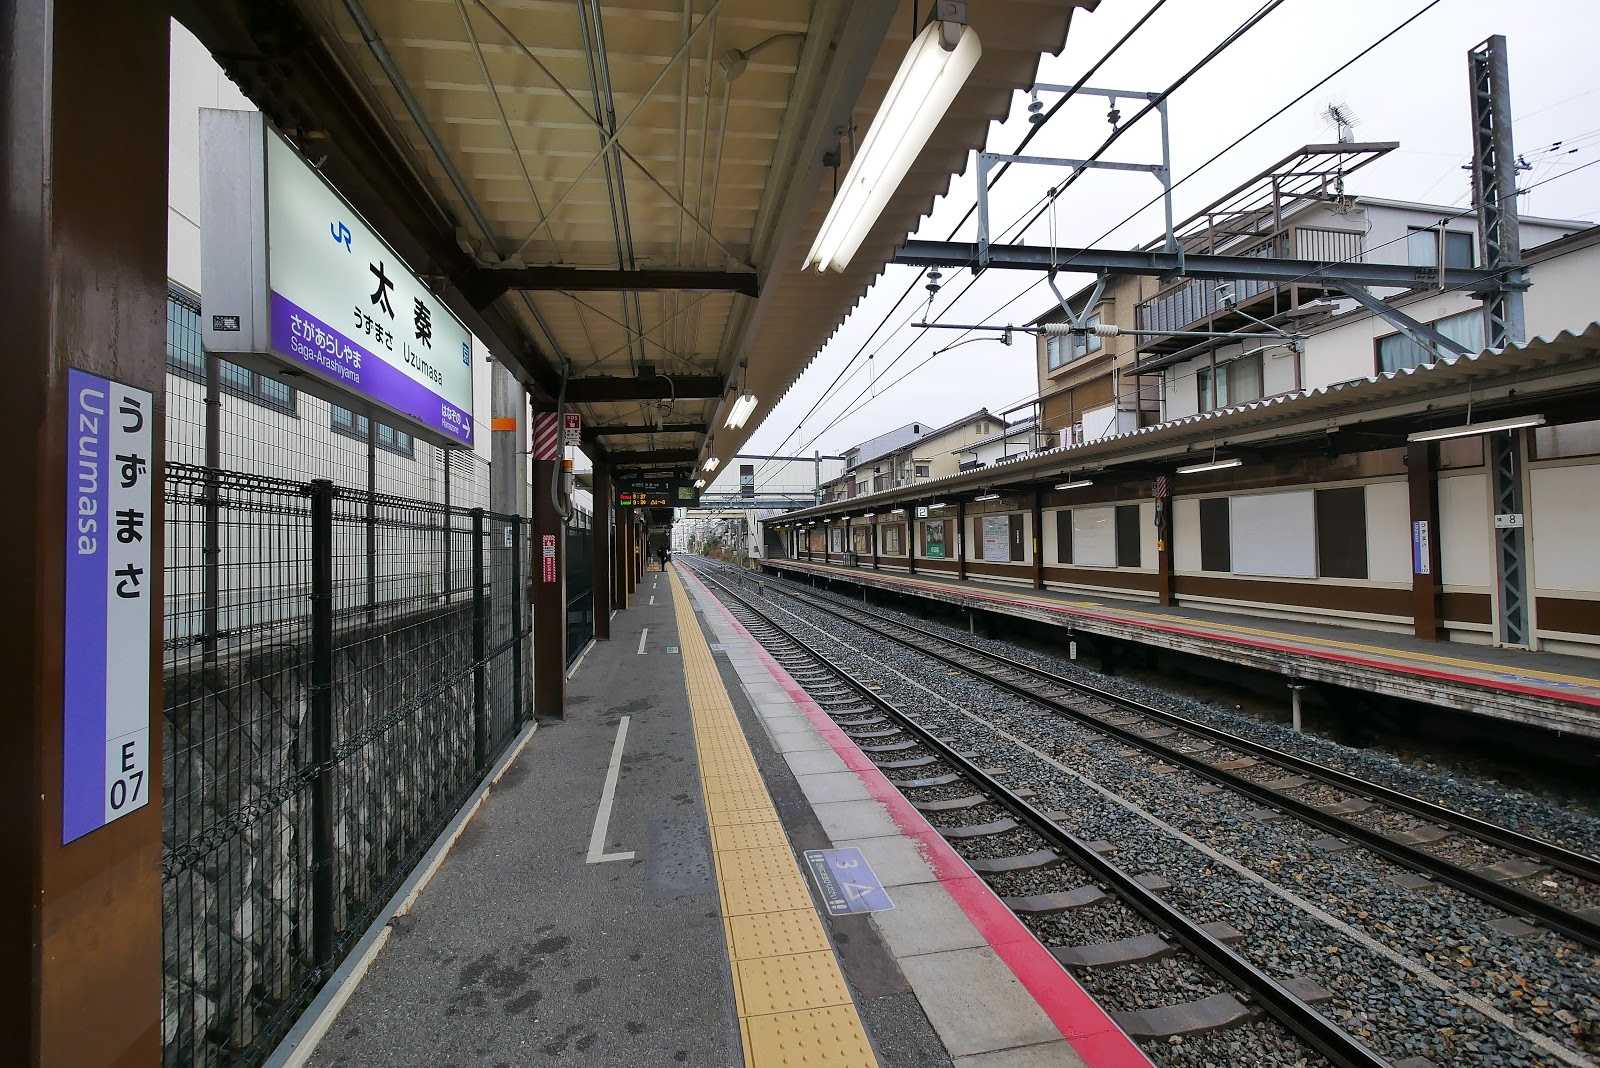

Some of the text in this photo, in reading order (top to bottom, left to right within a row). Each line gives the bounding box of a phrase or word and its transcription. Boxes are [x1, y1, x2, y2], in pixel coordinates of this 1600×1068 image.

[330, 220, 352, 254] JR
[369, 260, 432, 350] 太秦
[290, 313, 362, 369] さがあらしやま
[353, 305, 394, 352] うずまさ
[291, 335, 361, 384] Saga-Arashiyama
[402, 341, 443, 387] Uzumasa
[441, 402, 462, 425] はなぞの
[78, 387, 105, 556] Uzumasa
[114, 395, 147, 599] うずまさ
[1509, 515, 1516, 523] 8
[121, 740, 136, 773] E
[110, 769, 144, 810] 07
